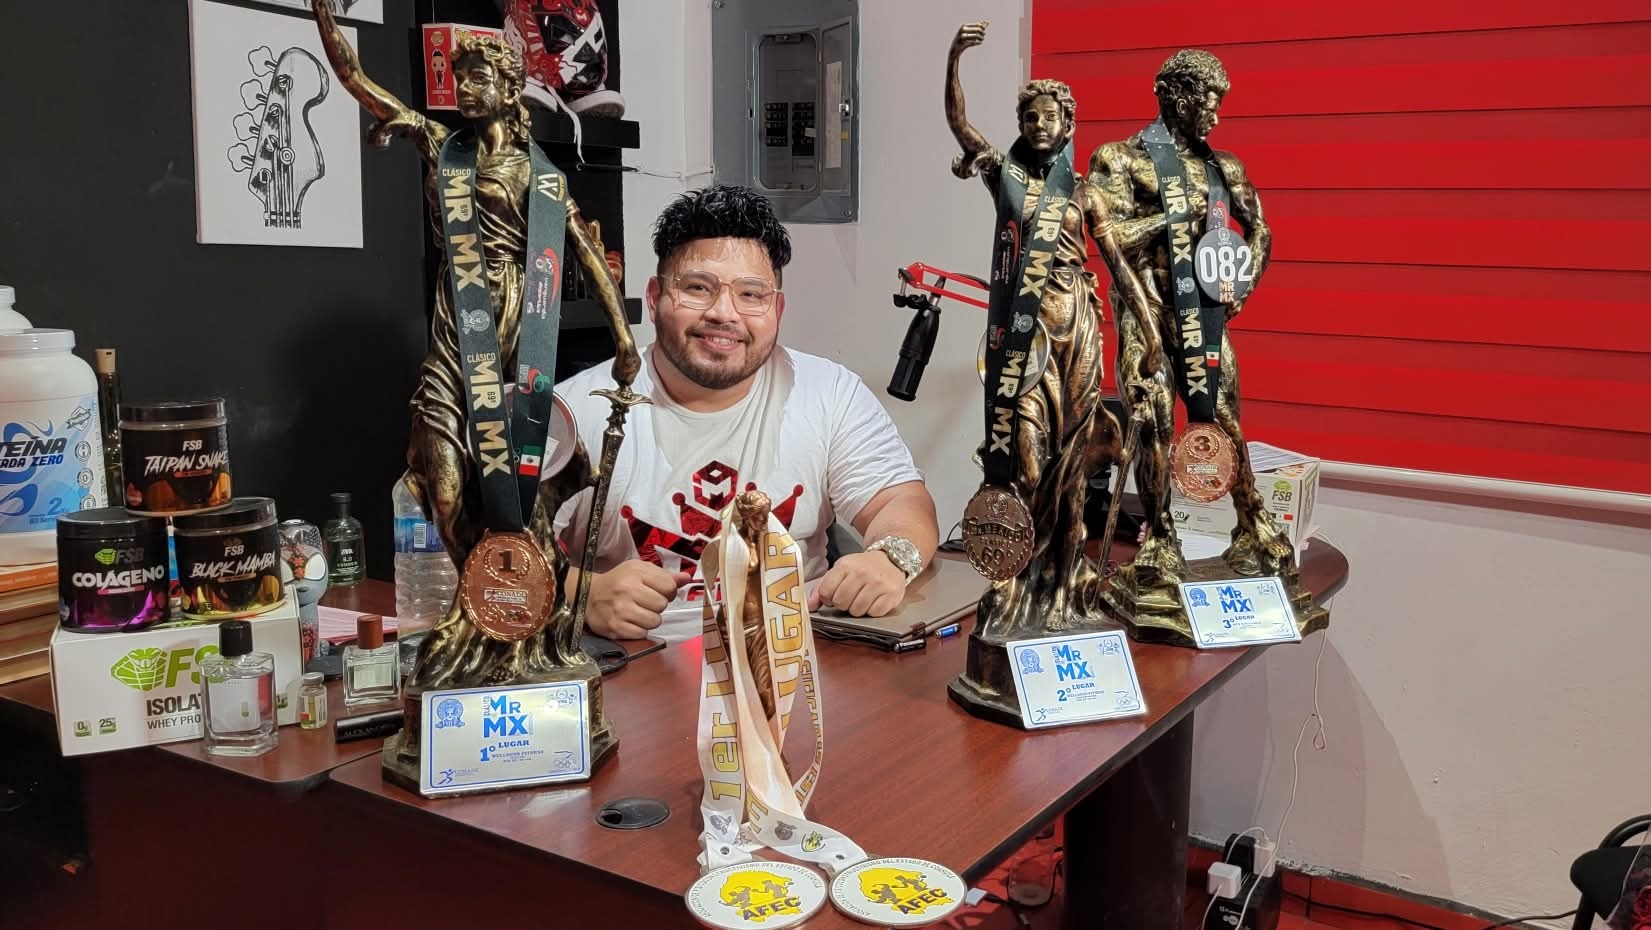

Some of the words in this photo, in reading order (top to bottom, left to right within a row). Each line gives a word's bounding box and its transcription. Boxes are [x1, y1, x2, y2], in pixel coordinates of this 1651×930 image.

[443, 176, 474, 224] MR
[1164, 181, 1188, 216] MR
[1034, 202, 1063, 242] MR
[1171, 221, 1192, 265] MX
[450, 233, 485, 292] MX
[1019, 250, 1052, 299] MX
[1199, 245, 1256, 283] 082
[1218, 281, 1235, 292] MR
[1219, 291, 1235, 303] MX
[1181, 313, 1203, 350] MR
[469, 361, 501, 411] MR
[997, 356, 1022, 399] MR
[1185, 355, 1209, 396] MX
[989, 406, 1014, 457] MX
[1194, 436, 1210, 451] 3
[182, 440, 203, 451] FSB
[475, 420, 512, 478] MX
[0, 458, 26, 469] ADA
[31, 454, 64, 467] ZERO
[144, 453, 195, 477] TAIPAN
[1272, 491, 1292, 501] FSB
[1174, 511, 1184, 519] 20
[116, 547, 145, 564] FSB
[224, 545, 245, 557] FSB
[499, 550, 513, 573] 1
[188, 561, 235, 579] BLACK
[234, 549, 276, 576] MAMBA
[72, 565, 165, 590] COLÁGENO
[1220, 599, 1251, 613] MX
[1056, 661, 1092, 682] MX
[146, 692, 201, 717] ISOLA
[147, 717, 178, 730] WHEY
[180, 714, 201, 725] PRO
[483, 714, 529, 738] MX
[498, 740, 530, 748] LUGAR
[709, 712, 742, 801] 1er
[743, 896, 801, 921] AFEC
[898, 888, 948, 914] AFEC
